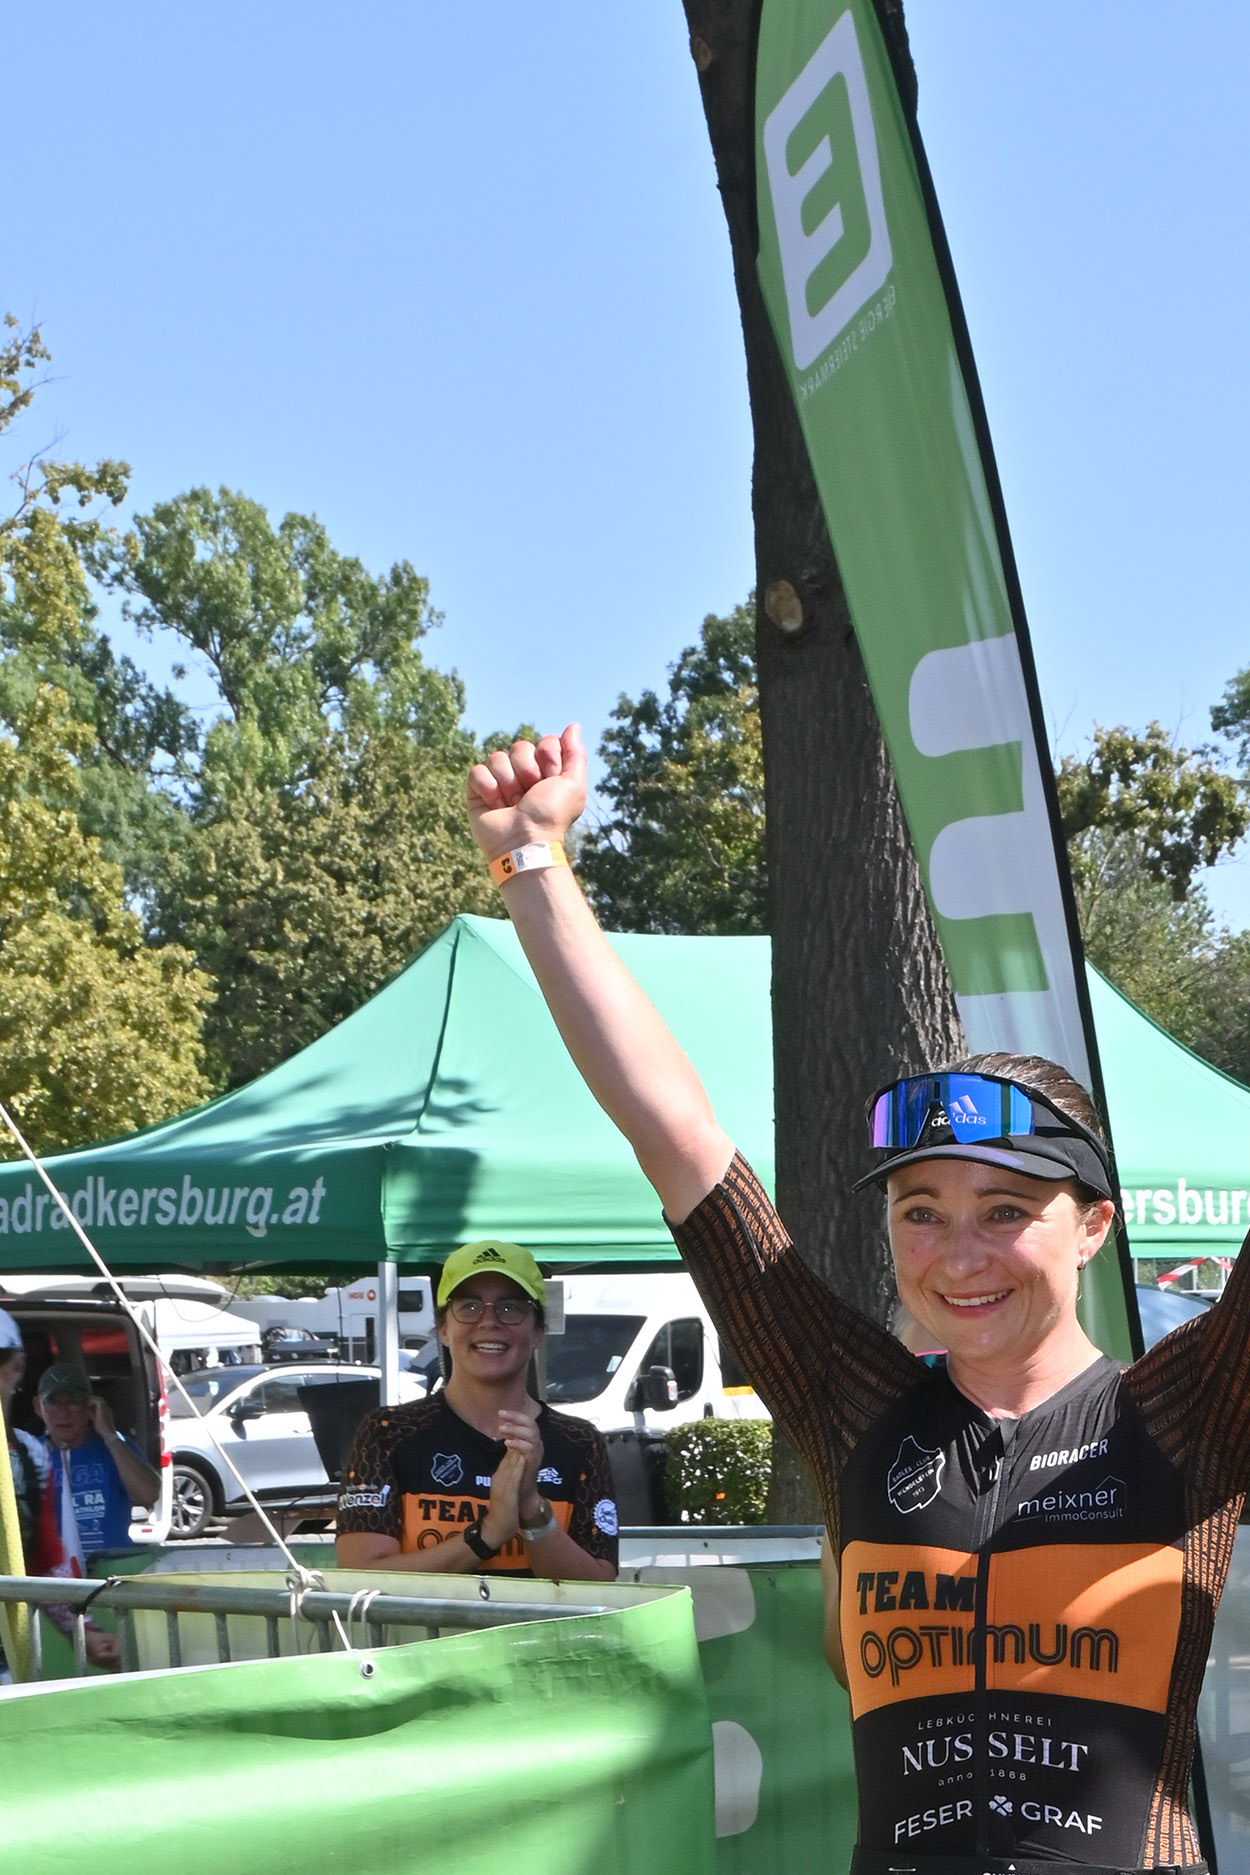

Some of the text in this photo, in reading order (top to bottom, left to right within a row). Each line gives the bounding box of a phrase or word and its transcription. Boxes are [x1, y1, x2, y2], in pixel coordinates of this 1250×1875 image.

[1029, 1438, 1109, 1472] BIORACER
[1017, 1486, 1119, 1517] meixner
[1044, 1508, 1124, 1523] ImmoConsult
[857, 1571, 977, 1615] TEAM
[860, 1623, 1119, 1687] optimum
[937, 1768, 1027, 1787] anno 1888
[894, 1799, 1103, 1844] FESER GRAF
